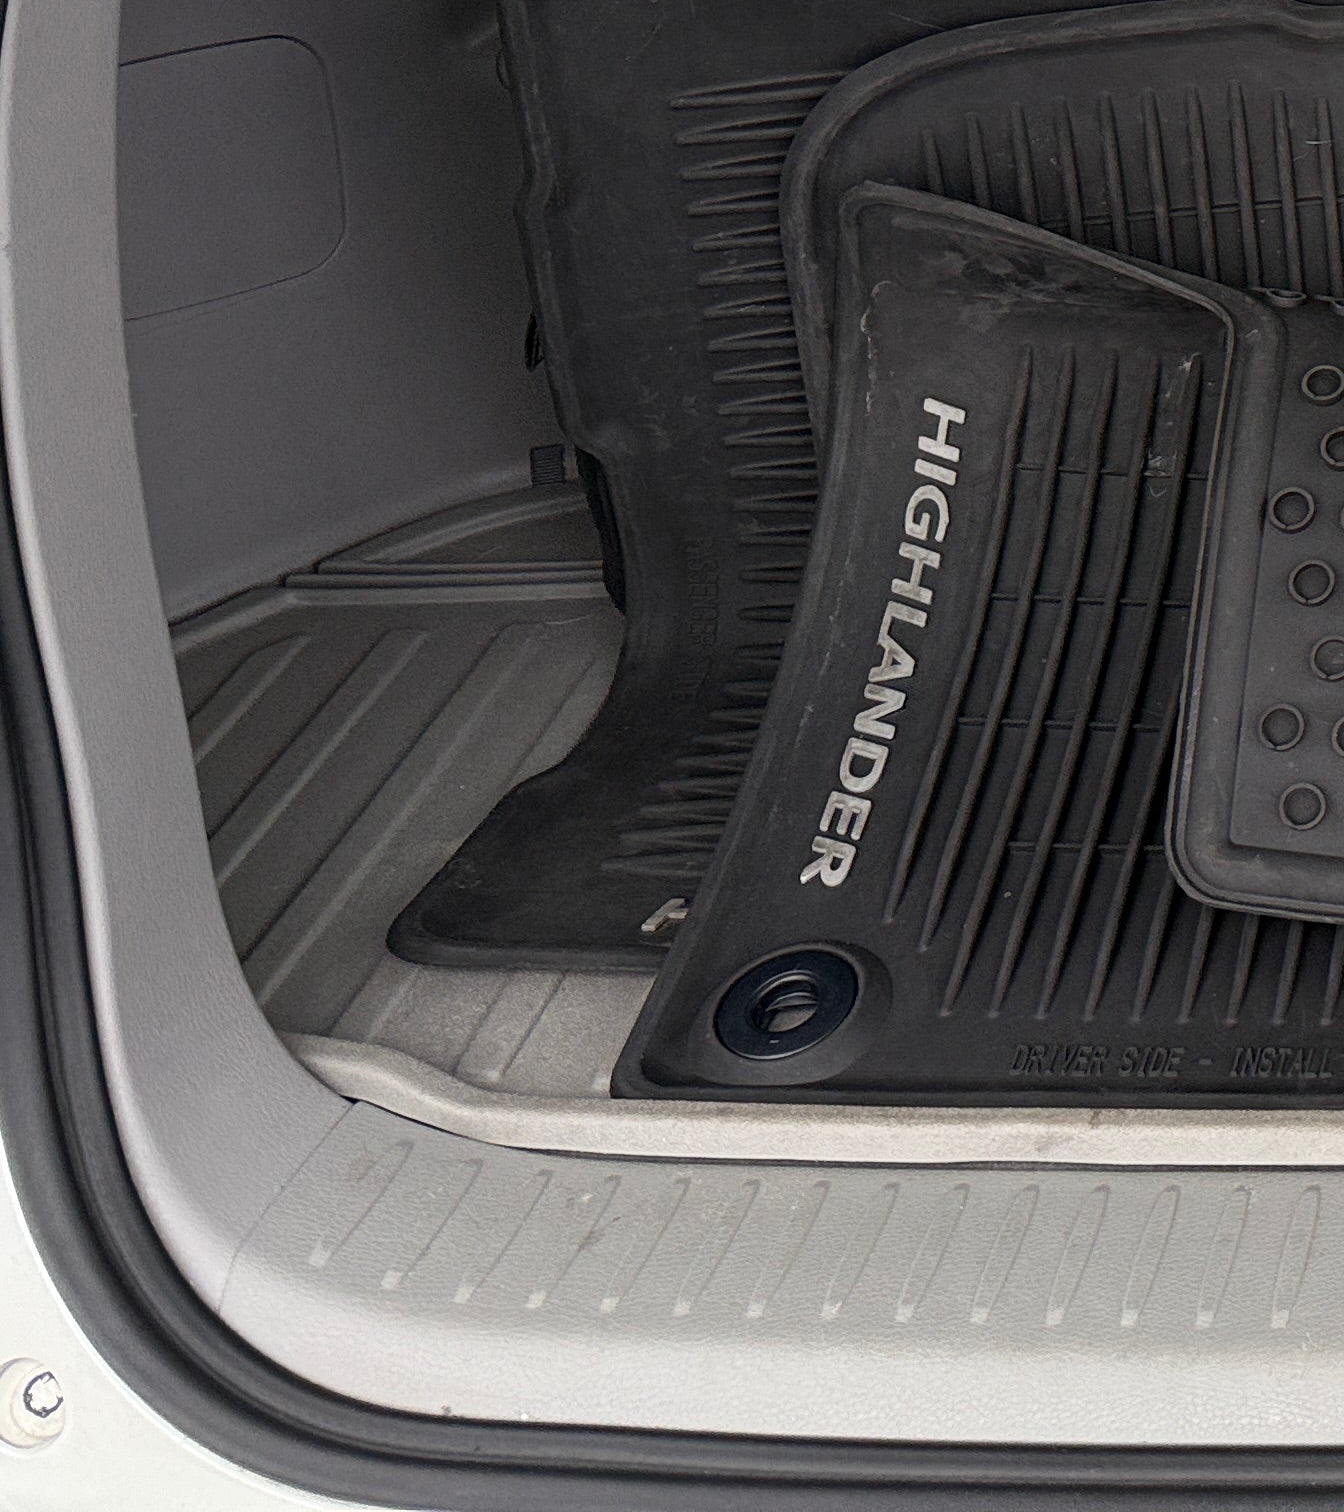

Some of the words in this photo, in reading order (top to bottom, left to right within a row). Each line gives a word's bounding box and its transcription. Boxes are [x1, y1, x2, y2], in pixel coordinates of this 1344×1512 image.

[800, 396, 967, 888] HIGHLANDER
[1009, 1044, 1110, 1079] DRIVER
[1118, 1046, 1186, 1079] SIDE
[1229, 1046, 1335, 1079] INSTALL
